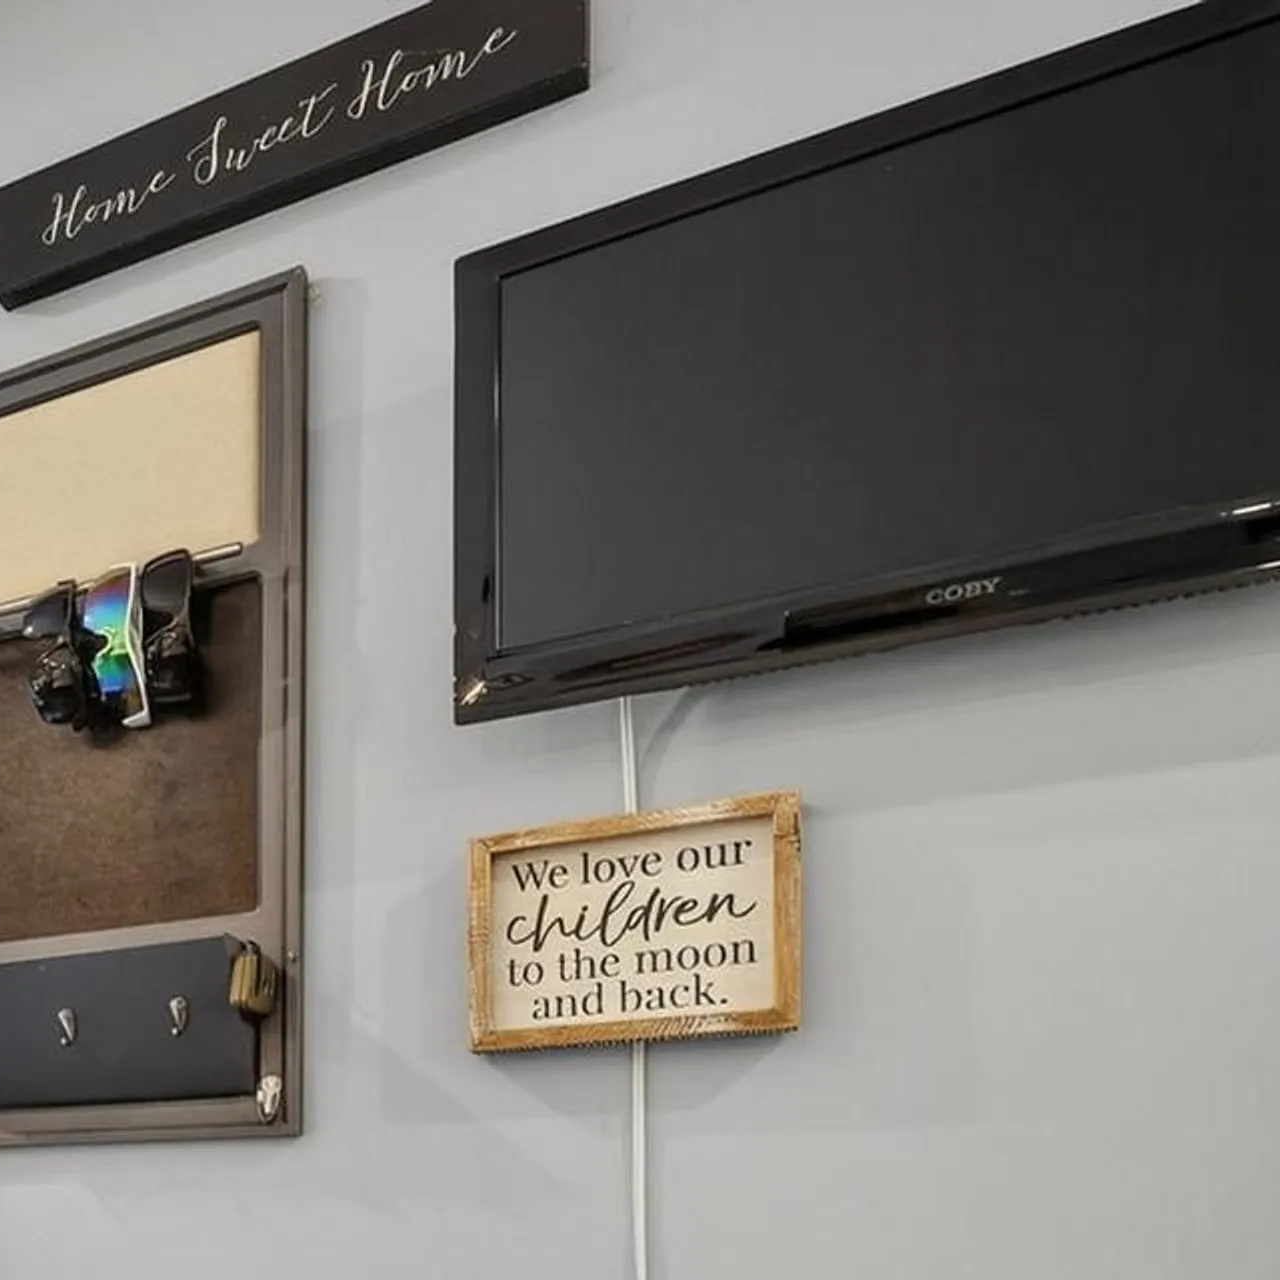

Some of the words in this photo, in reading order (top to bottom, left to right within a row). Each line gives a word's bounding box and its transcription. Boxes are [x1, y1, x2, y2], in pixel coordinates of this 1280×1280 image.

[42, 170, 175, 245] Home
[186, 82, 338, 184] Sweet
[347, 27, 516, 119] Home
[925, 576, 1004, 605] COBY
[512, 859, 570, 892] We
[580, 849, 663, 886] love
[676, 839, 753, 873] our
[506, 880, 758, 952] children
[508, 958, 544, 988] to
[558, 948, 621, 982] the
[634, 938, 758, 974] moon
[532, 982, 604, 1021] and
[619, 973, 729, 1014] back.
